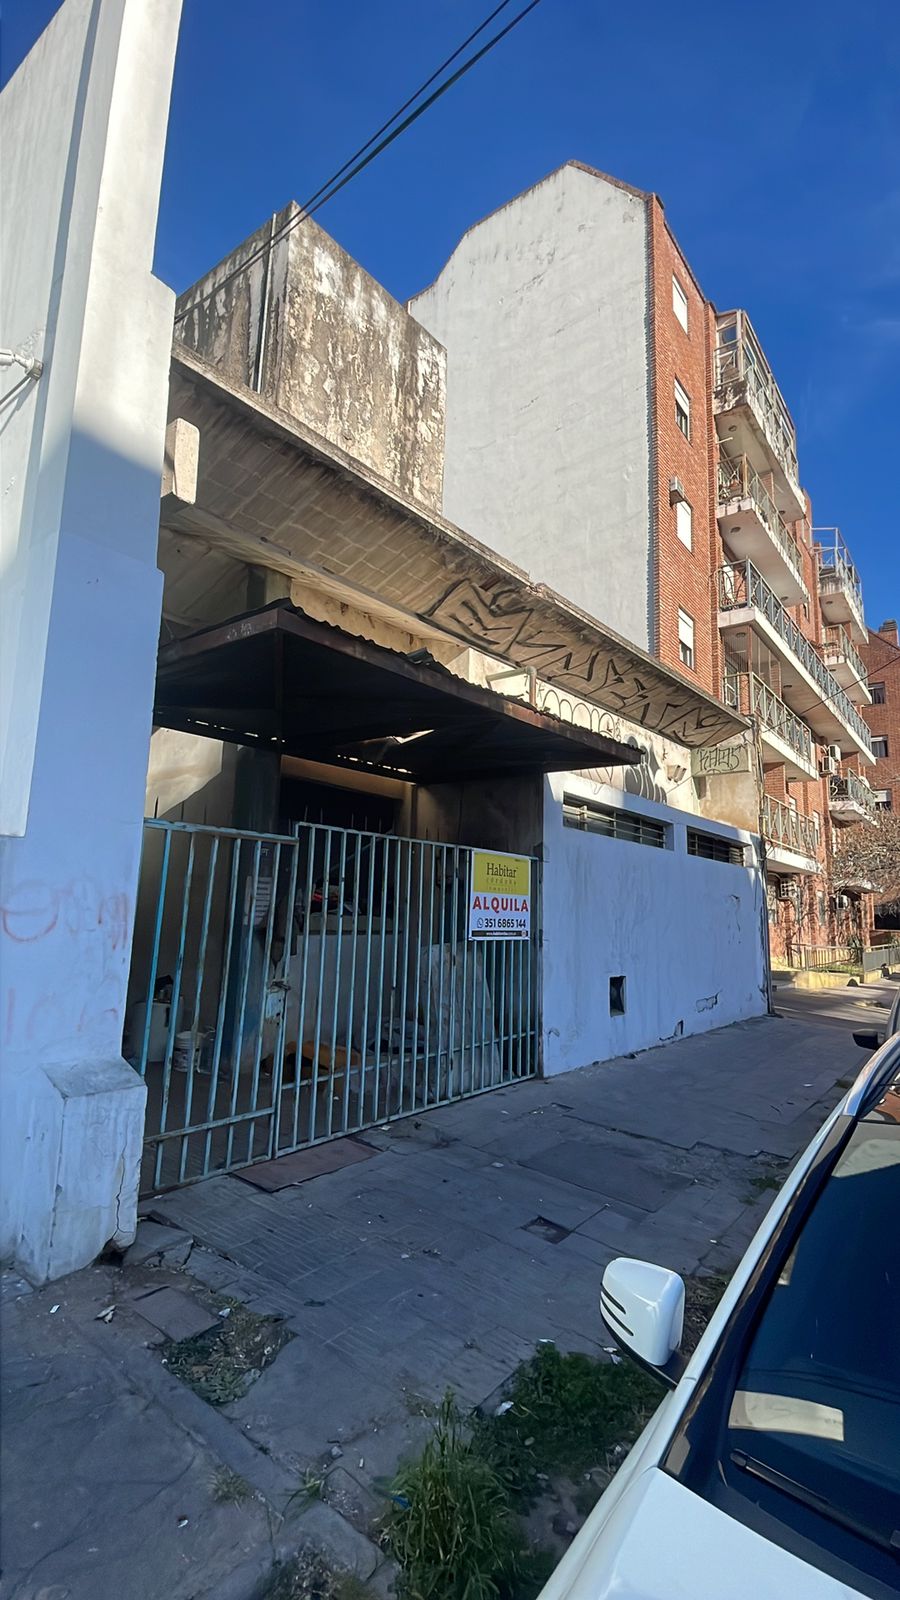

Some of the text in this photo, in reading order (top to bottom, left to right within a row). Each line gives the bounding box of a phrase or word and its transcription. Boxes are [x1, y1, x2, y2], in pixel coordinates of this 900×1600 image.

[486, 862, 517, 878] Habitar
[472, 895, 529, 914] ALQUILA
[484, 918, 526, 928] 351 6865 144
